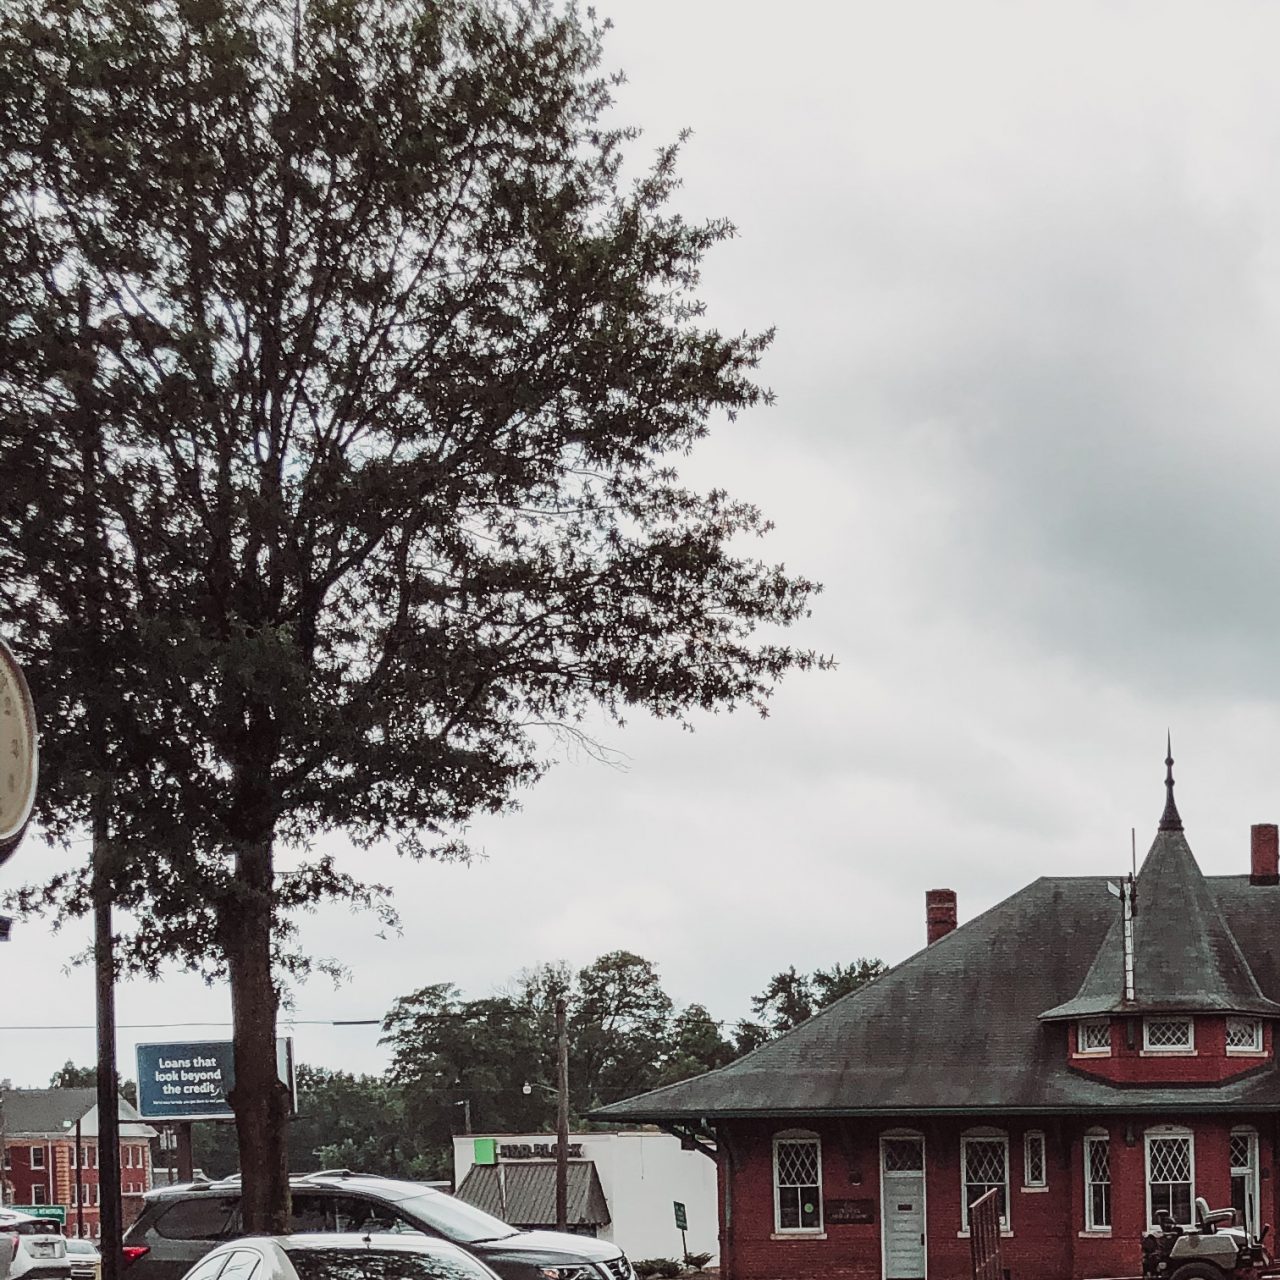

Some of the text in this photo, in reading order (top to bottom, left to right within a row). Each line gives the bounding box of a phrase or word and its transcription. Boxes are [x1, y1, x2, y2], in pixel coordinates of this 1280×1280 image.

[159, 1056, 217, 1068] Loans that
[155, 1069, 222, 1083] look beyond
[162, 1083, 181, 1094] the
[500, 1143, 583, 1158] H&R BLOK
